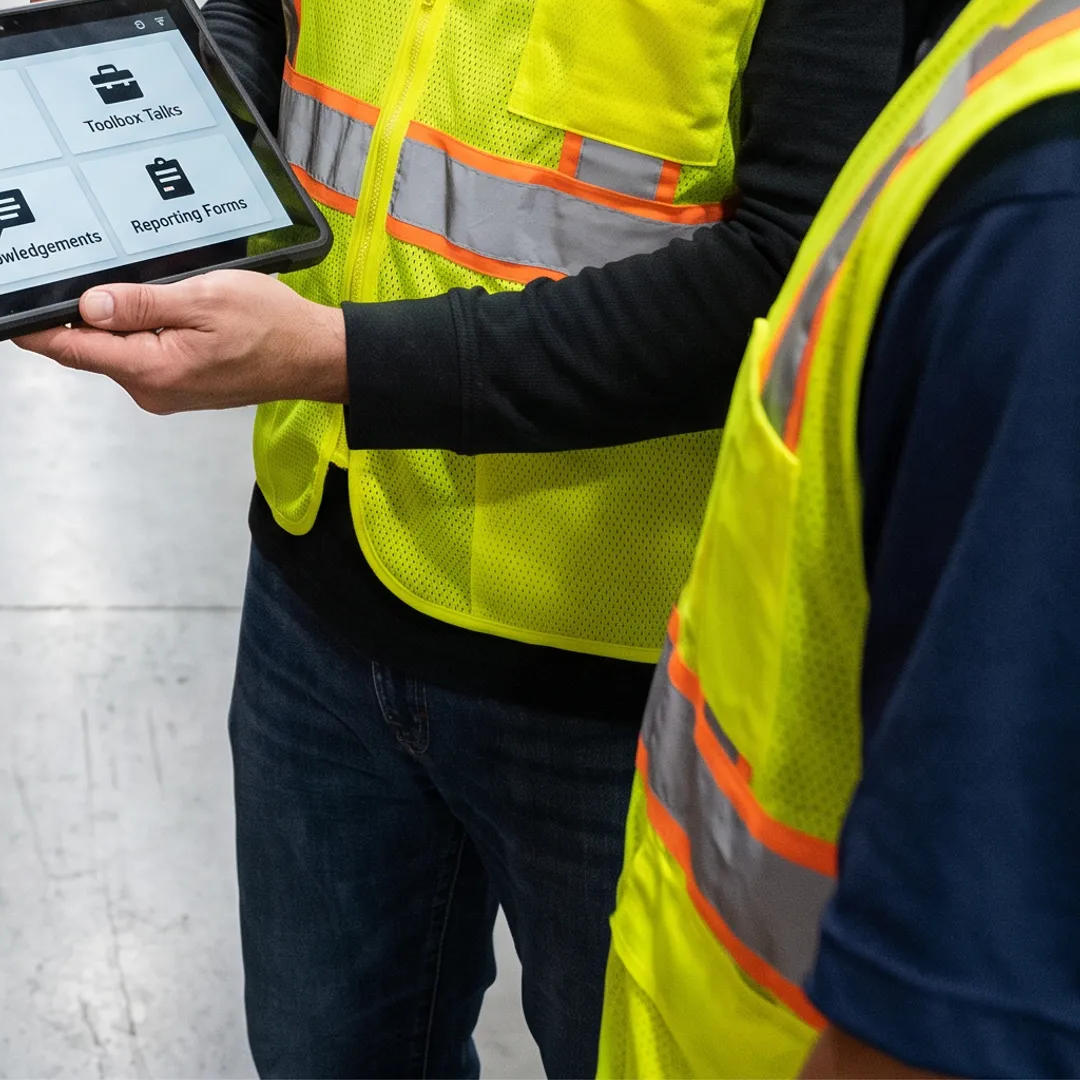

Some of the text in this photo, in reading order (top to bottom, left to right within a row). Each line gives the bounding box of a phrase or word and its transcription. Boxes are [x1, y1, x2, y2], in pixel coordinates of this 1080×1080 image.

[83, 104, 183, 133] Toolbox Talks
[131, 198, 248, 234] Reporting Forms
